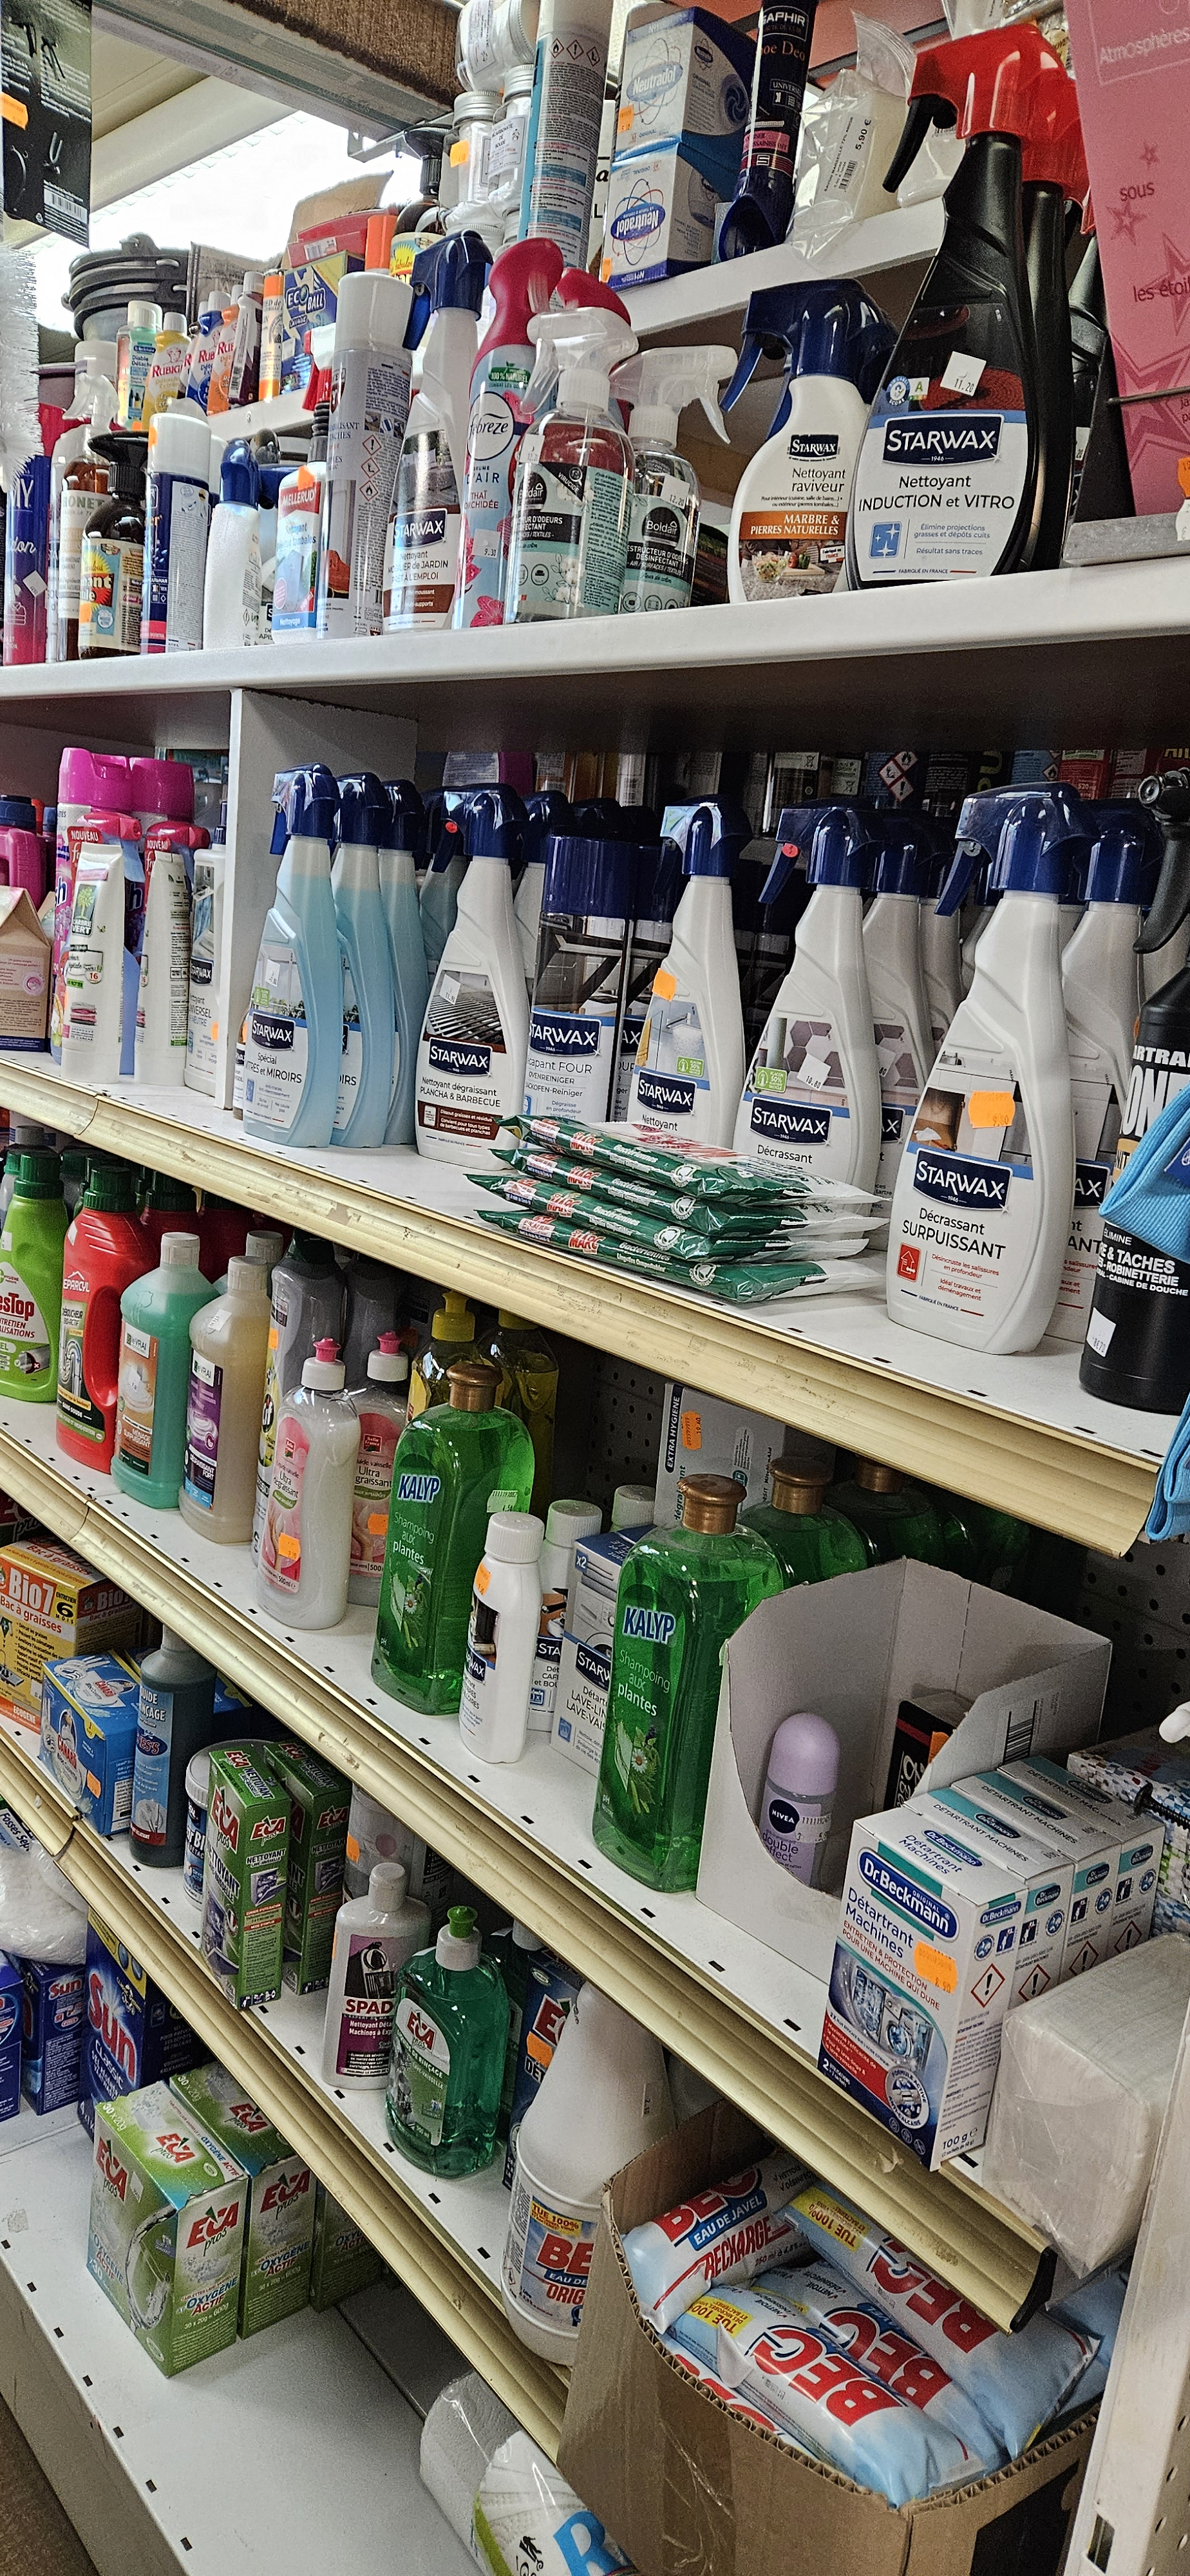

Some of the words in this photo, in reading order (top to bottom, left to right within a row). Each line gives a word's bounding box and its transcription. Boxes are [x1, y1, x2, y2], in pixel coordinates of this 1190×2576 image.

[782, 41, 805, 61] Deo
[633, 65, 676, 95] Neutradol
[855, 129, 867, 150] 5,90
[1119, 181, 1155, 202] sous
[616, 210, 659, 238] Neutradol
[307, 292, 324, 312] BALL
[1133, 284, 1154, 303] les
[954, 379, 974, 393] 11.20
[469, 413, 509, 435] febreze
[791, 439, 836, 455] STARWAX
[887, 430, 995, 453] STARWAX
[466, 473, 500, 484] D'AIR
[558, 471, 580, 493] VIRUCIDE
[792, 468, 846, 480] Nettoyant
[899, 475, 971, 489] Nettoyant
[471, 491, 487, 500] THAÏ
[791, 480, 845, 493] raviveur
[281, 489, 316, 511] MELLERUD
[669, 494, 685, 506] 12.20
[859, 494, 942, 512] INDUCTION
[946, 495, 959, 507] et
[965, 494, 1015, 509] VITRO
[532, 516, 563, 525] D'ODEURS
[647, 521, 677, 534] Boldair
[750, 525, 782, 535] PIERRES
[784, 524, 838, 535] NATURELLES
[784, 515, 829, 525] MARBRE
[831, 515, 840, 524] &
[920, 522, 945, 532] Élimine
[946, 524, 985, 533] projections
[914, 531, 938, 540] grasses
[948, 531, 972, 540] dépôts
[412, 560, 420, 569] de
[420, 559, 449, 569] JARDIN
[409, 571, 439, 581] L'EMPLOI
[71, 831, 99, 842] NOUVEAU
[147, 839, 168, 849] NOUVEAU
[71, 925, 91, 934] VERT
[89, 972, 98, 980] 16
[252, 1019, 292, 1043] STARWAX
[258, 1052, 277, 1065] Spécial
[430, 1045, 488, 1069] STARWAX
[559, 1062, 592, 1074] FOUR
[266, 1070, 302, 1083] MIROIRS
[422, 1076, 451, 1090] Nettoyant
[451, 1081, 497, 1097] dégraissant
[529, 1072, 574, 1084] OVENREINIGER
[806, 1075, 821, 1089] 10.80
[420, 1086, 448, 1101] PLANCHA
[455, 1092, 501, 1108] BARBECUE
[638, 1080, 692, 1106] STARWAX
[642, 1115, 677, 1132] Nettoyant
[752, 1107, 826, 1136] STARWAX
[757, 1144, 813, 1164] Décrassant
[916, 1160, 1005, 1200] STARWAX
[947, 1195, 959, 1203] 1946
[919, 1208, 985, 1236] Décrassant
[902, 1220, 1006, 1260] SURPUISSANT
[1103, 1227, 1132, 1246] ÉLIMINE
[932, 1253, 961, 1267] Désincruste
[970, 1262, 999, 1276] salissures
[1116, 1250, 1175, 1273] TACHES
[951, 1266, 982, 1280] profondeur
[1106, 1262, 1179, 1287] ROBINETTERIE
[63, 1278, 90, 1293] EPARCYL
[937, 1285, 981, 1301] déménagement
[940, 1278, 952, 1286] Idéal
[954, 1282, 974, 1293] travaux
[1109, 1274, 1135, 1288] CABINE
[1137, 1282, 1148, 1291] DE
[1149, 1285, 1189, 1296] DOUCHE
[942, 1303, 959, 1311] FRANCE
[670, 1397, 680, 1437] HYGIENE
[667, 1439, 675, 1468] EXTRA
[279, 1471, 292, 1485] Ultra
[359, 1466, 380, 1477] Ultra
[398, 1475, 440, 1502] KALYP
[394, 1511, 435, 1544] Shampoing
[393, 1540, 424, 1565] plantes
[9, 1567, 54, 1614] Bio7
[56, 1591, 77, 1604] ENTRETIEN
[1, 1595, 15, 1611] Bac
[16, 1604, 22, 1615] à
[24, 1611, 62, 1634] graisses
[56, 1602, 74, 1618] 6
[623, 1606, 675, 1644] KALYP
[619, 1650, 670, 1694] Shampoing
[628, 1674, 645, 1691] aux
[618, 1683, 657, 1716] plantes
[14, 1705, 36, 1724] ECOGENE
[57, 1732, 77, 1770] CANARD
[245, 1766, 274, 1801] NETTOYANT
[211, 1785, 240, 1853] ECA
[250, 1816, 286, 1841] ECA
[771, 1810, 795, 1825] NIVEA
[762, 1831, 799, 1855] double
[905, 1834, 962, 1873] Détartrant
[925, 1830, 978, 1867] Dr.Beckmann
[983, 1835, 1029, 1862] MACHINES
[246, 1848, 286, 1865] NETTOYANT
[898, 1839, 949, 1875] Machines
[862, 1855, 949, 1933] Dr.Beckmann
[912, 1889, 940, 1913] ORIGINAL
[847, 1886, 914, 1949] Détartrant
[845, 1902, 904, 1958] Machines
[844, 1920, 878, 1952] ENTRETIEN
[884, 1953, 927, 1991] PROTECTION
[843, 1928, 860, 1947] POUR
[861, 1944, 874, 1960] UNE
[875, 1956, 905, 1984] MACHINE
[920, 1993, 940, 2011] DURE
[48, 1978, 82, 2001] Sun
[345, 1999, 393, 2015] SPAD
[88, 1973, 136, 2086] Sun
[349, 2028, 373, 2037] Machines
[350, 2021, 377, 2031] Nettoyant
[406, 2010, 436, 2051] ECA
[419, 2057, 443, 2078] RINÇAGE
[155, 2132, 196, 2164] ECA
[942, 2134, 959, 2148] 100
[260, 2170, 310, 2213] ECA
[187, 2202, 239, 2249] ECA
[532, 2203, 552, 2220] TUE
[552, 2210, 580, 2230] 100%
[694, 2222, 717, 2248] EAU
[716, 2212, 731, 2232] DE
[731, 2193, 763, 2222] JAVEL
[260, 2240, 310, 2272] OXYGÈNE
[704, 2215, 774, 2279] RECHARGE
[266, 2256, 298, 2278] ACTIF
[185, 2277, 238, 2309] OXYGÈNE
[191, 2294, 225, 2317] ACTIF
[749, 2327, 904, 2428] BEC
